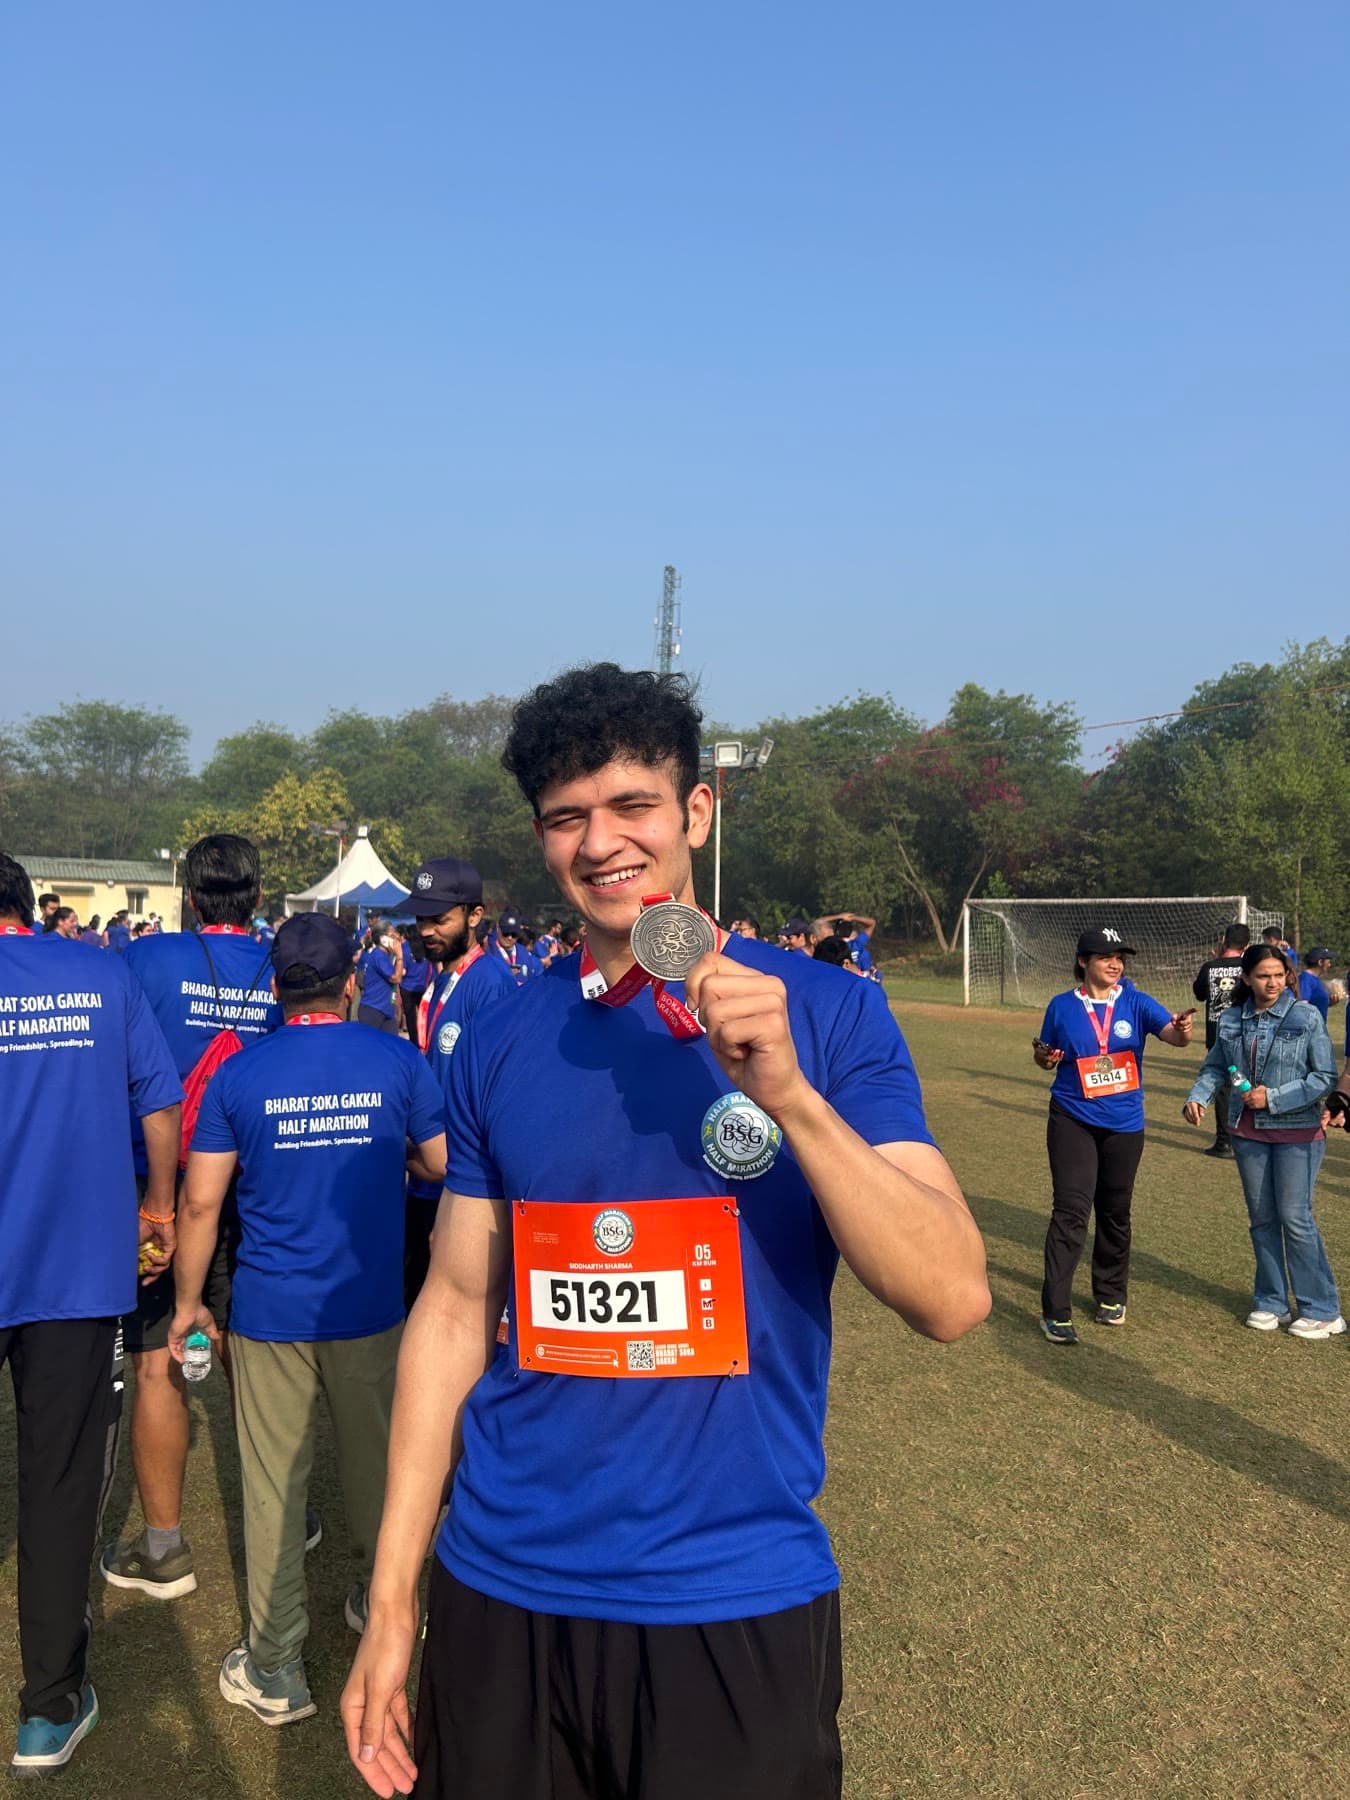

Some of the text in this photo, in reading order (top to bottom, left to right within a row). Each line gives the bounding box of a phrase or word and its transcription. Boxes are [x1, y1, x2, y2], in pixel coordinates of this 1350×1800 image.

[20, 994, 55, 1013] SOKA
[57, 993, 103, 1009] GAKKAI
[219, 987, 244, 1001] SOKA
[246, 989, 277, 1005] GAKKA
[661, 994, 682, 1014] SOKA
[190, 1001, 215, 1016] HALF
[0, 1015, 90, 1037] LF MARATHON
[9, 1041, 49, 1053] Friendships,
[49, 1038, 83, 1050] Spreading
[83, 1037, 95, 1048] Joy
[1090, 1071, 1122, 1085] 51414
[265, 1092, 382, 1115] BHARAT SOKA GAKKAI
[707, 1098, 729, 1122] HALF
[278, 1114, 369, 1135] HALF MARATHON
[722, 1123, 763, 1144] BSG
[334, 1136, 363, 1147] Spreading
[706, 1143, 774, 1173] HALF MARATHON
[602, 1226, 624, 1237] BSG
[695, 1244, 712, 1260] 05
[550, 1278, 658, 1324] 51321
